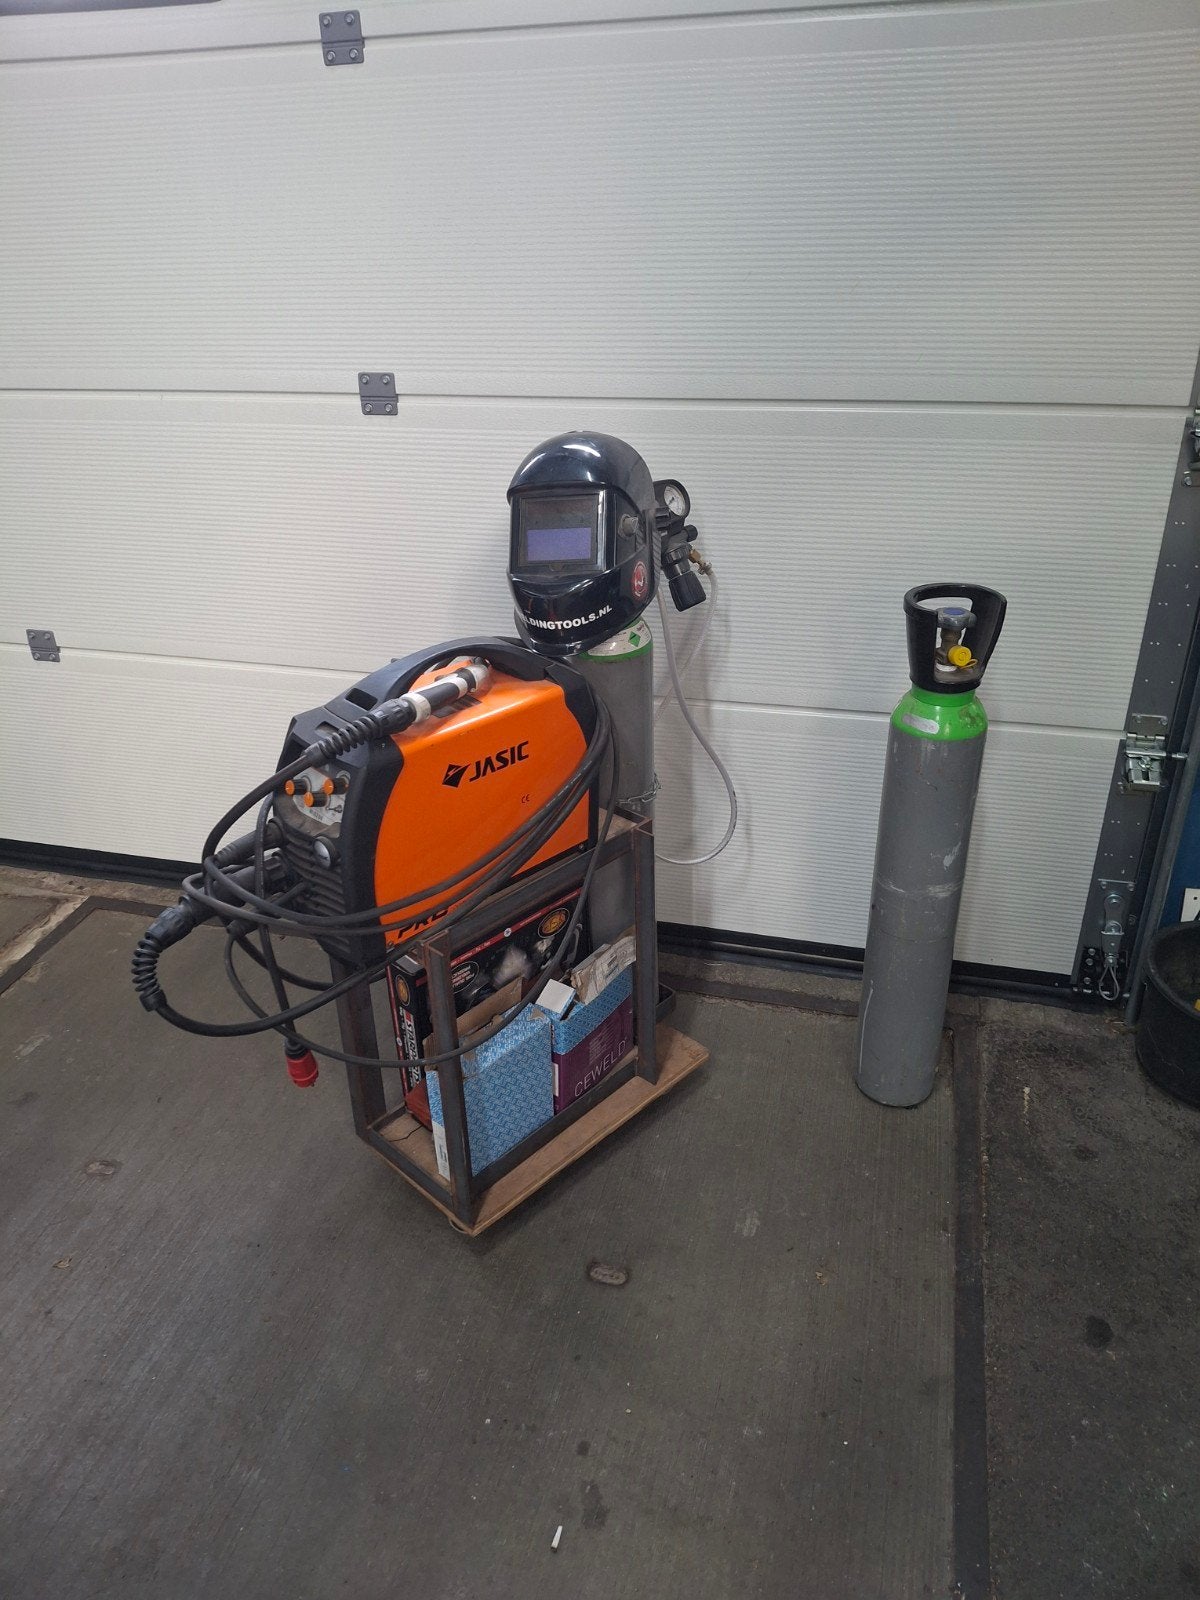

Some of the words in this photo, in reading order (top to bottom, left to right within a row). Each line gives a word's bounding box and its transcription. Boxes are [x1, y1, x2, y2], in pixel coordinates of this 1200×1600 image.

[521, 604, 613, 630] LDINGTOOLS.NL
[469, 740, 529, 782] JASIC
[574, 1040, 626, 1097] CEWELD
